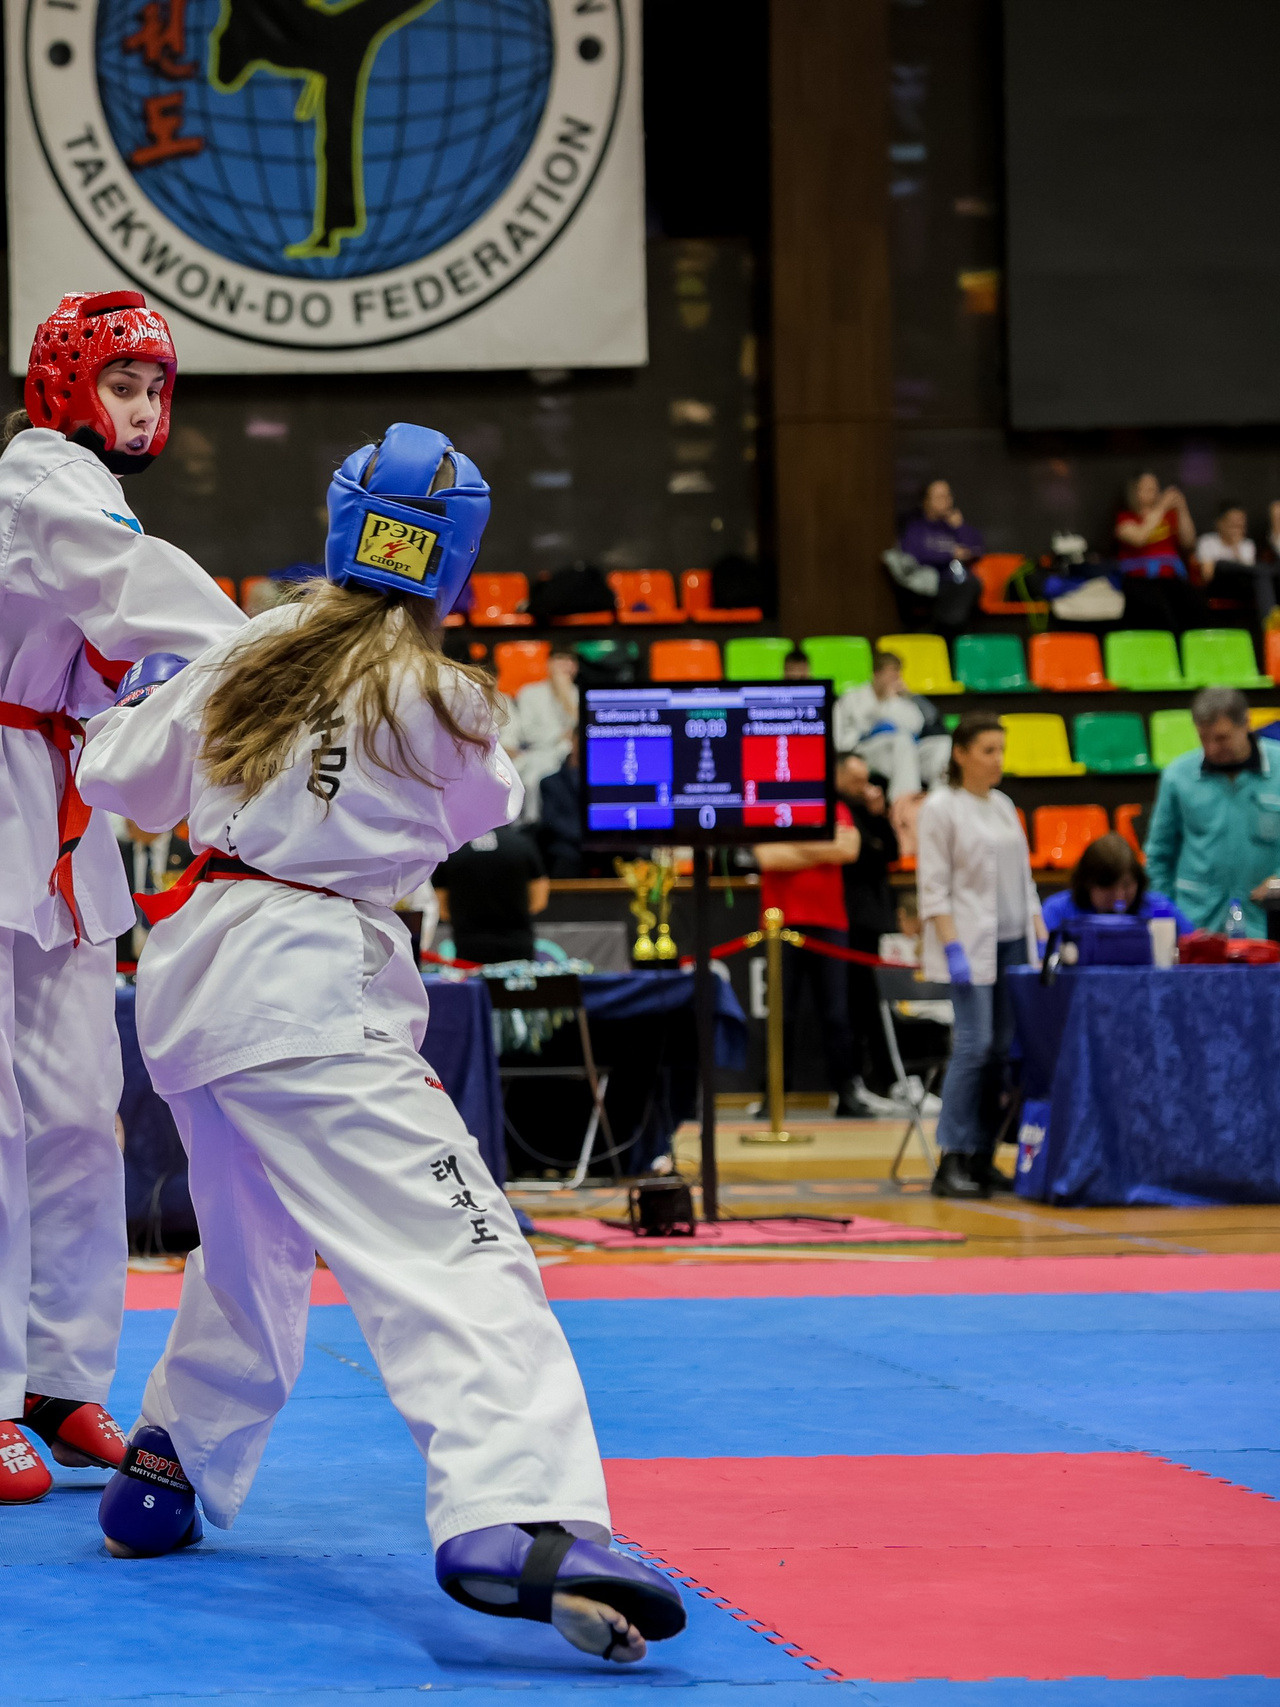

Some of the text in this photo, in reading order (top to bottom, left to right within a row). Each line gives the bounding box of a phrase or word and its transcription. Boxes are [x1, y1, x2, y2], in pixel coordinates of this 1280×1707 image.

[65, 115, 594, 327] TAEKWON-DO FEDERATION
[369, 519, 429, 555] РЭЙ
[369, 554, 411, 572] спорт
[624, 806, 638, 830] 1
[699, 805, 716, 829] 0
[774, 803, 793, 828] 3
[2, 1454, 37, 1474] TEN
[130, 1465, 151, 1477] SAFETY
[157, 1476, 169, 1484] OUR
[143, 1494, 156, 1509] S
